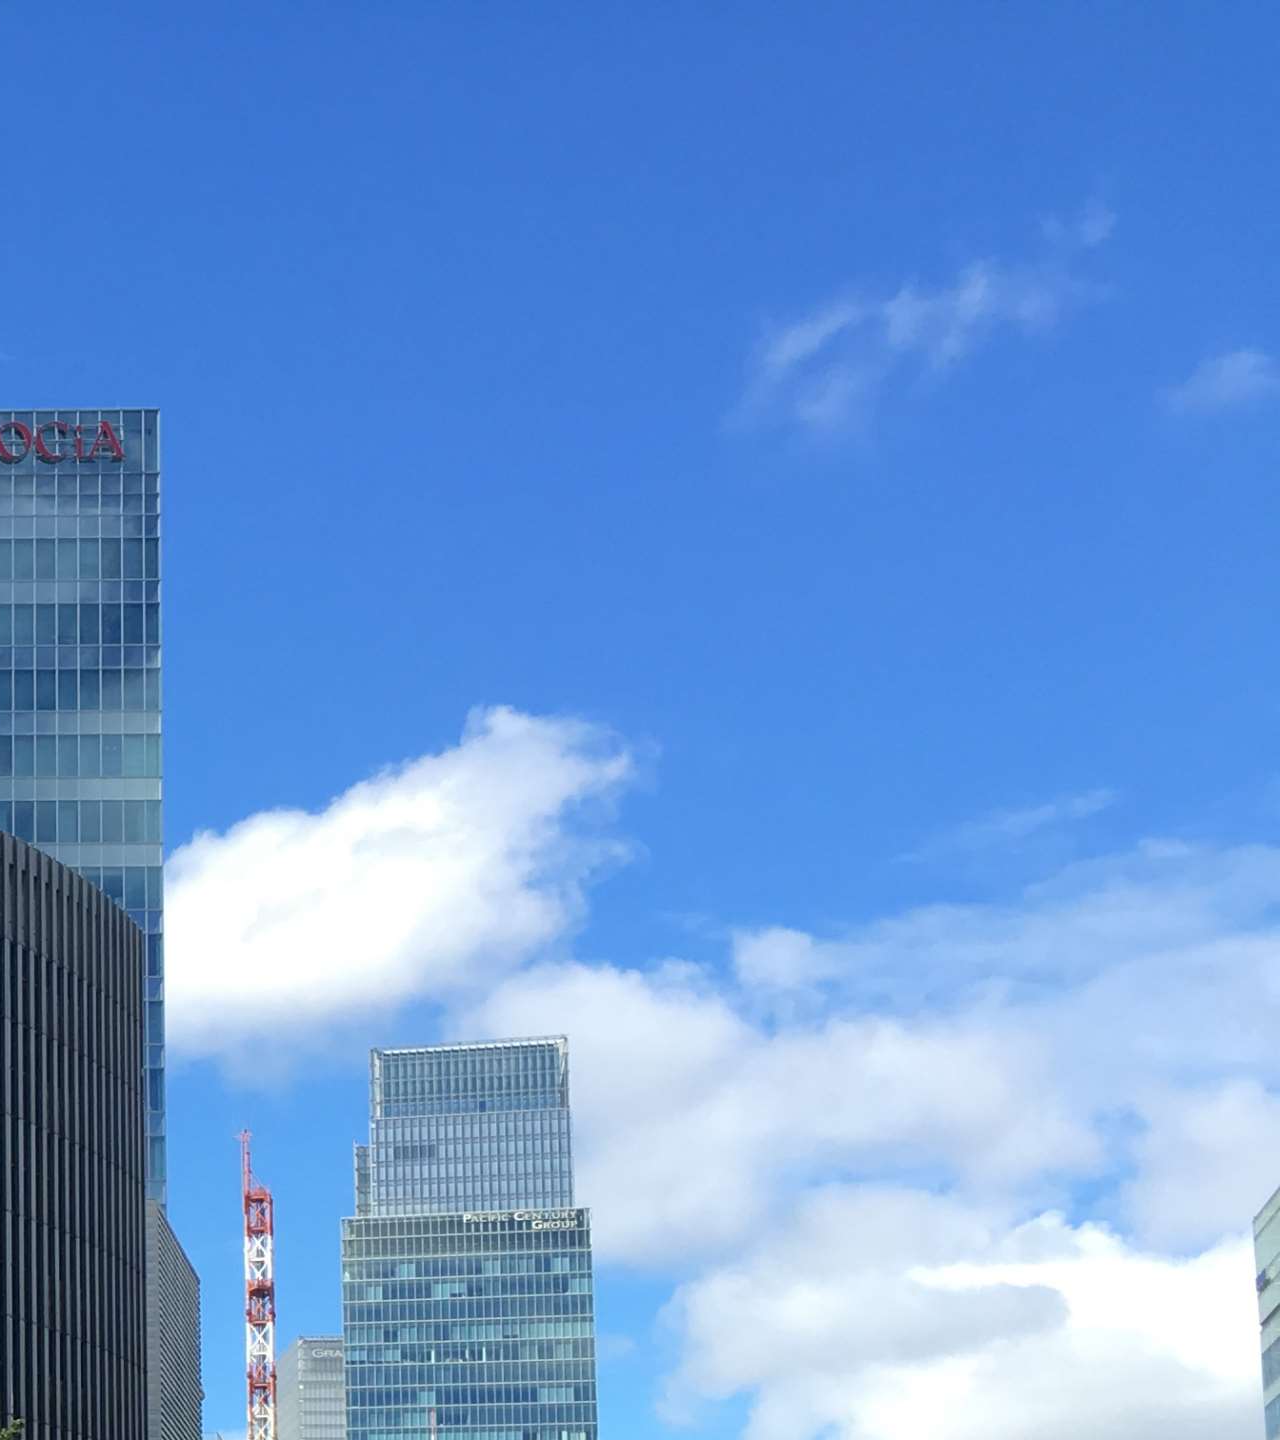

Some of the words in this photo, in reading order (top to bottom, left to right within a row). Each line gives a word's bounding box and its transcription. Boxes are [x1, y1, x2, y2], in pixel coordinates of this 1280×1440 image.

[463, 1213, 510, 1223] PACIFIC
[513, 1209, 577, 1221] CENTURY
[532, 1219, 578, 1230] GROUP
